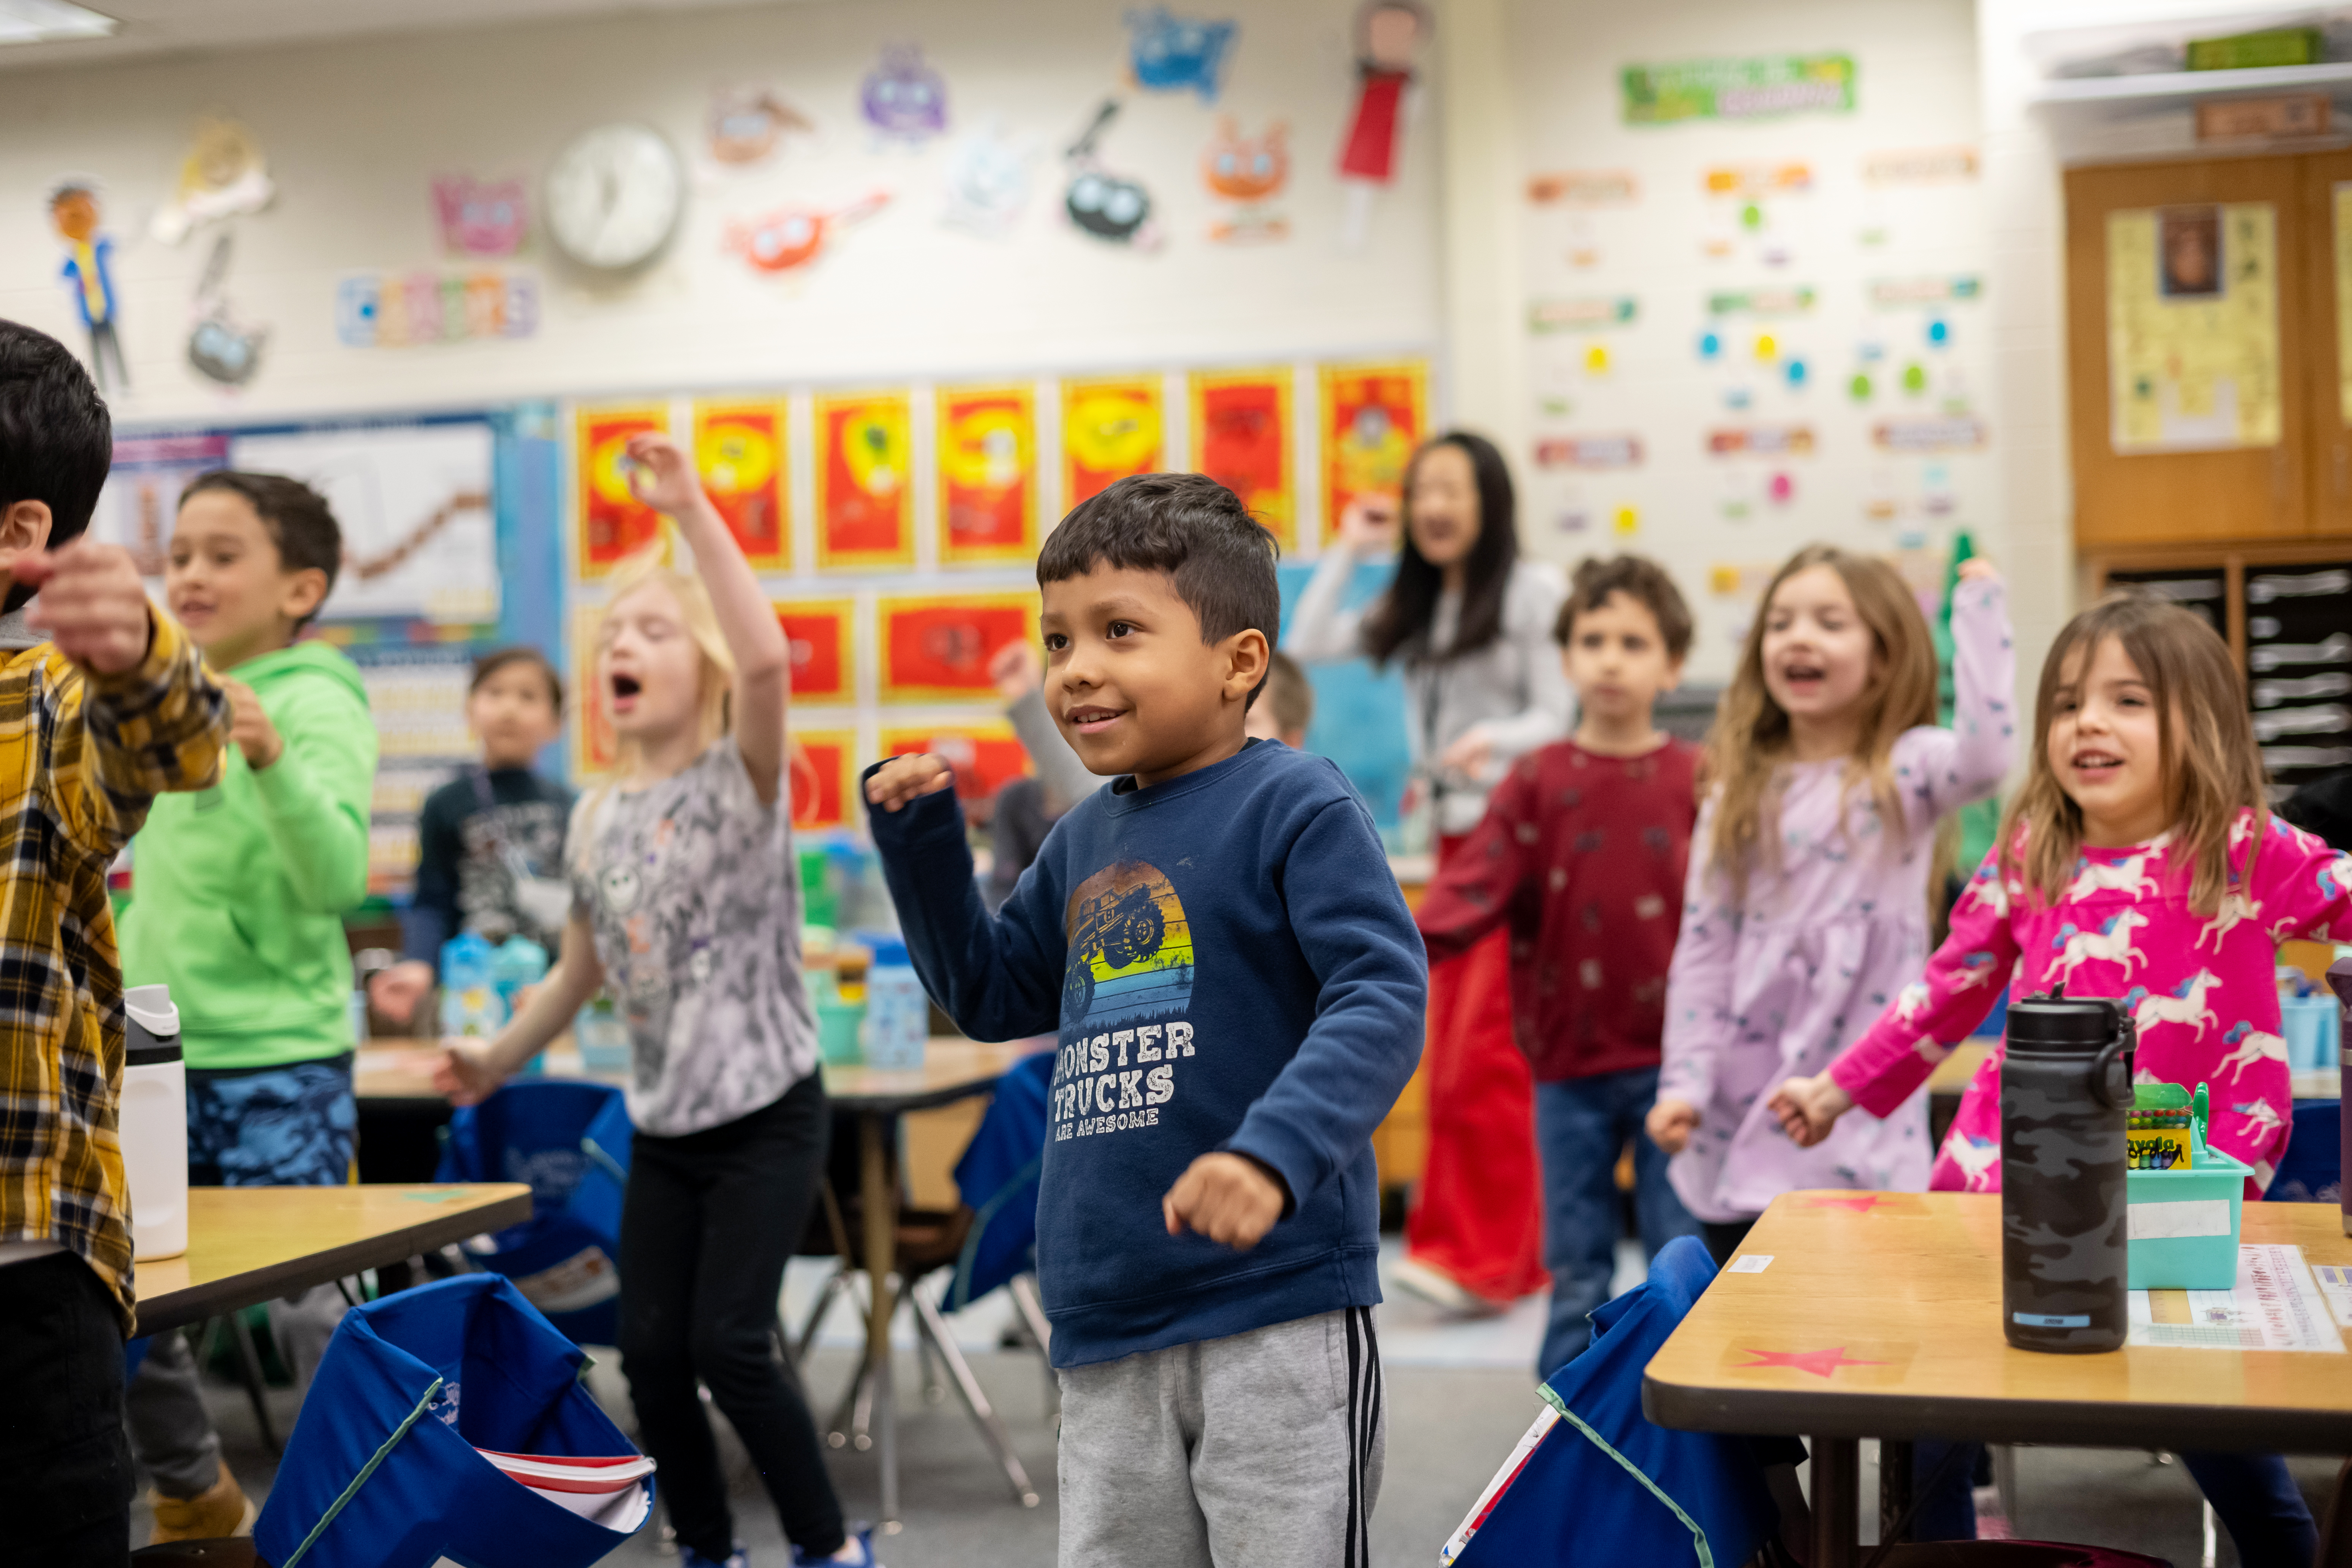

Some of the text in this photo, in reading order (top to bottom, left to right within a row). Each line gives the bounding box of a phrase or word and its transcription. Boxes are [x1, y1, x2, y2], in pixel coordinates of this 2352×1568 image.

[1054, 1021, 1195, 1086] MONSTER
[1055, 1064, 1174, 1122] TRUCKS
[1055, 1108, 1159, 1142] ARE AWESOME
[2127, 1136, 2175, 1154] ayola
[2127, 1138, 2184, 1163] ordan
